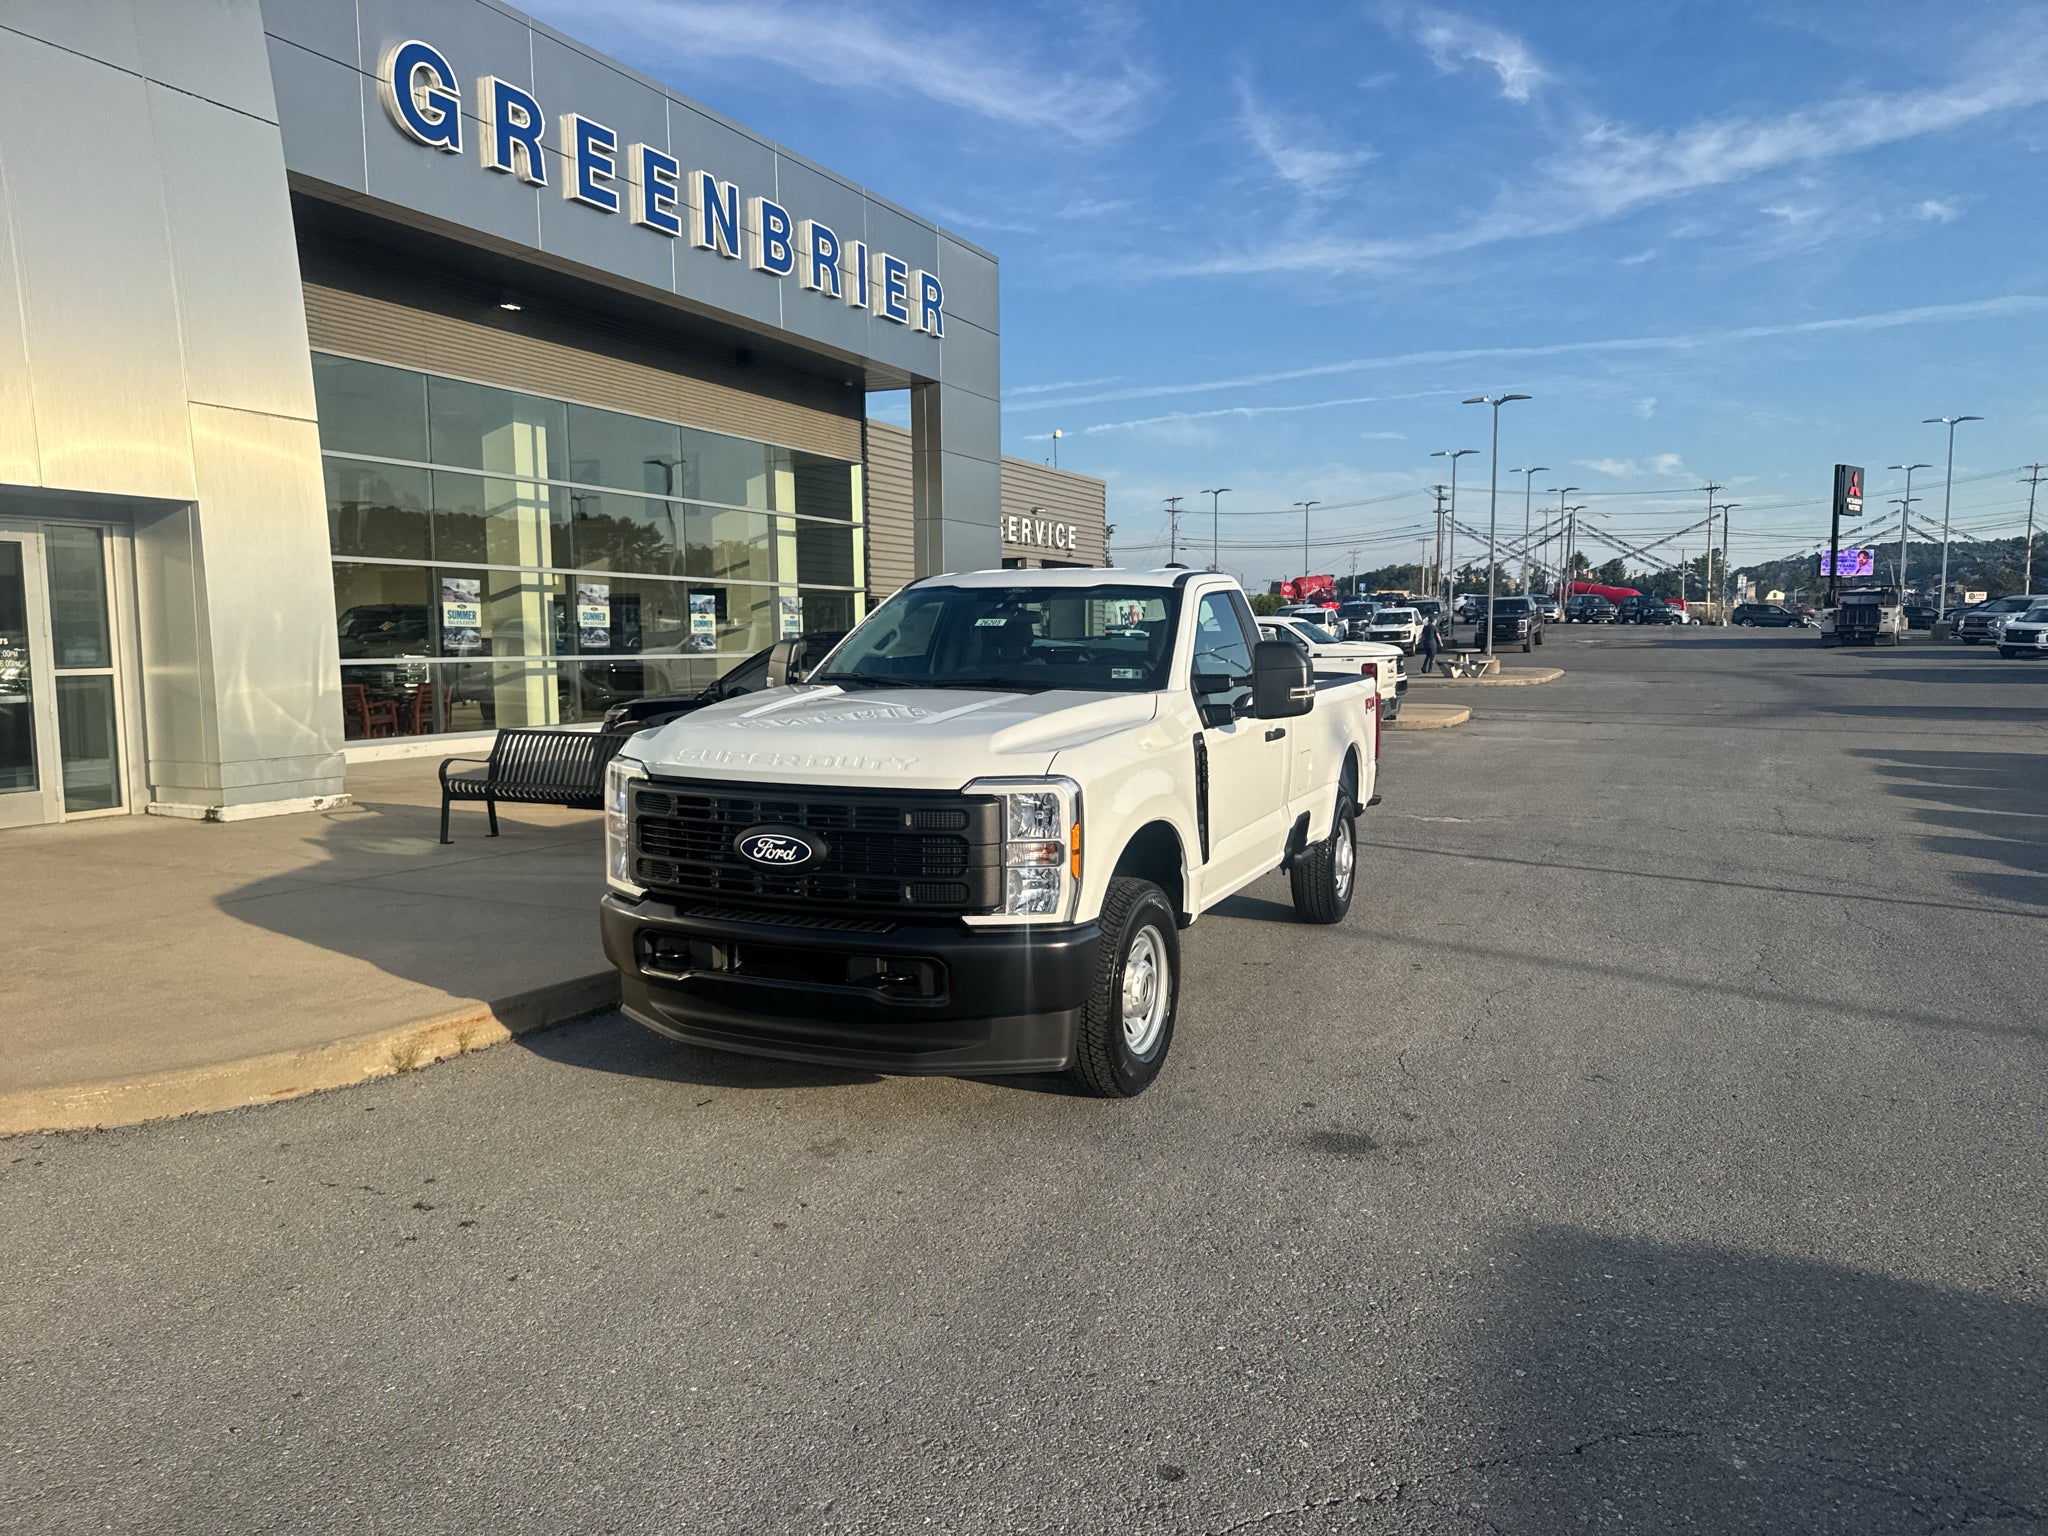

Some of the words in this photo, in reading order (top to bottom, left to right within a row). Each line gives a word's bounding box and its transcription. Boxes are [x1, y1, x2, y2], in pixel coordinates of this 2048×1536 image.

[382, 39, 944, 338] GREENBRIER
[447, 610, 477, 620] SUMMER
[582, 612, 606, 621] SUMMER
[675, 748, 800, 766] SUPER
[806, 754, 919, 770] DUTY
[753, 838, 798, 861] Ford
